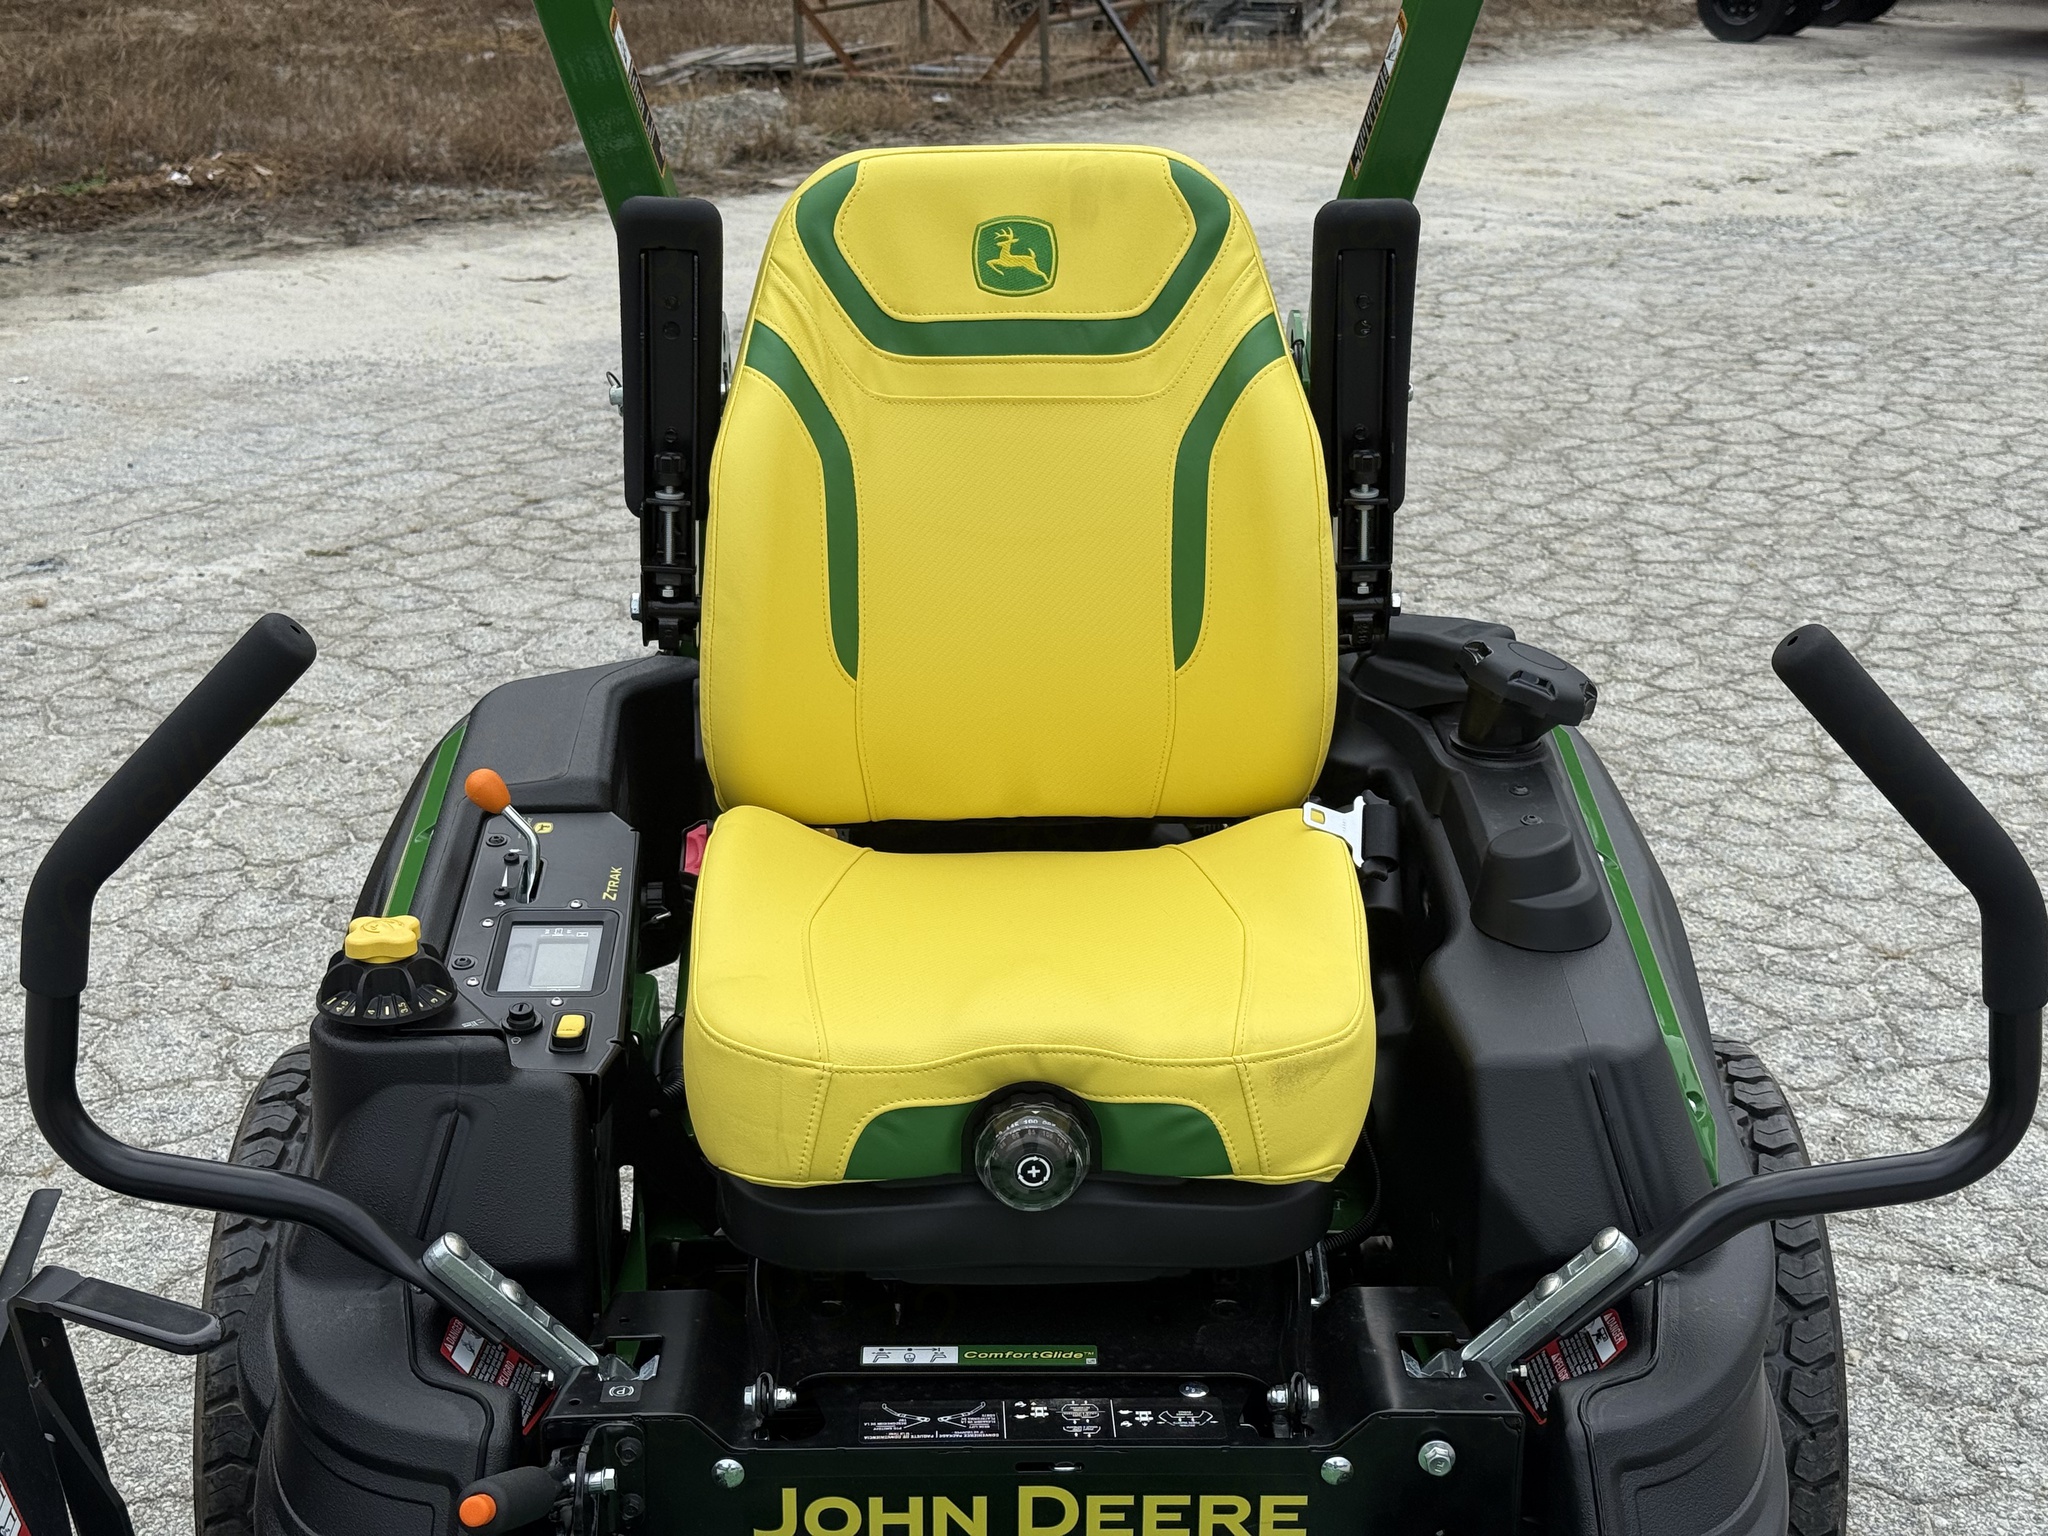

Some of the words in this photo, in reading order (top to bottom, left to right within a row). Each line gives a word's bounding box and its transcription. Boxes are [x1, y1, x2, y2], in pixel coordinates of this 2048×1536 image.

[602, 866, 623, 901] ZTRAK
[397, 1001, 409, 1014] 3.5
[448, 1319, 464, 1344] DANGER
[1606, 1317, 1625, 1344] DANGER
[497, 1360, 515, 1387] PELIGRO
[1555, 1358, 1570, 1382] PELIGR
[753, 1488, 987, 1536] JOHN
[1017, 1486, 1309, 1536] DEERE
